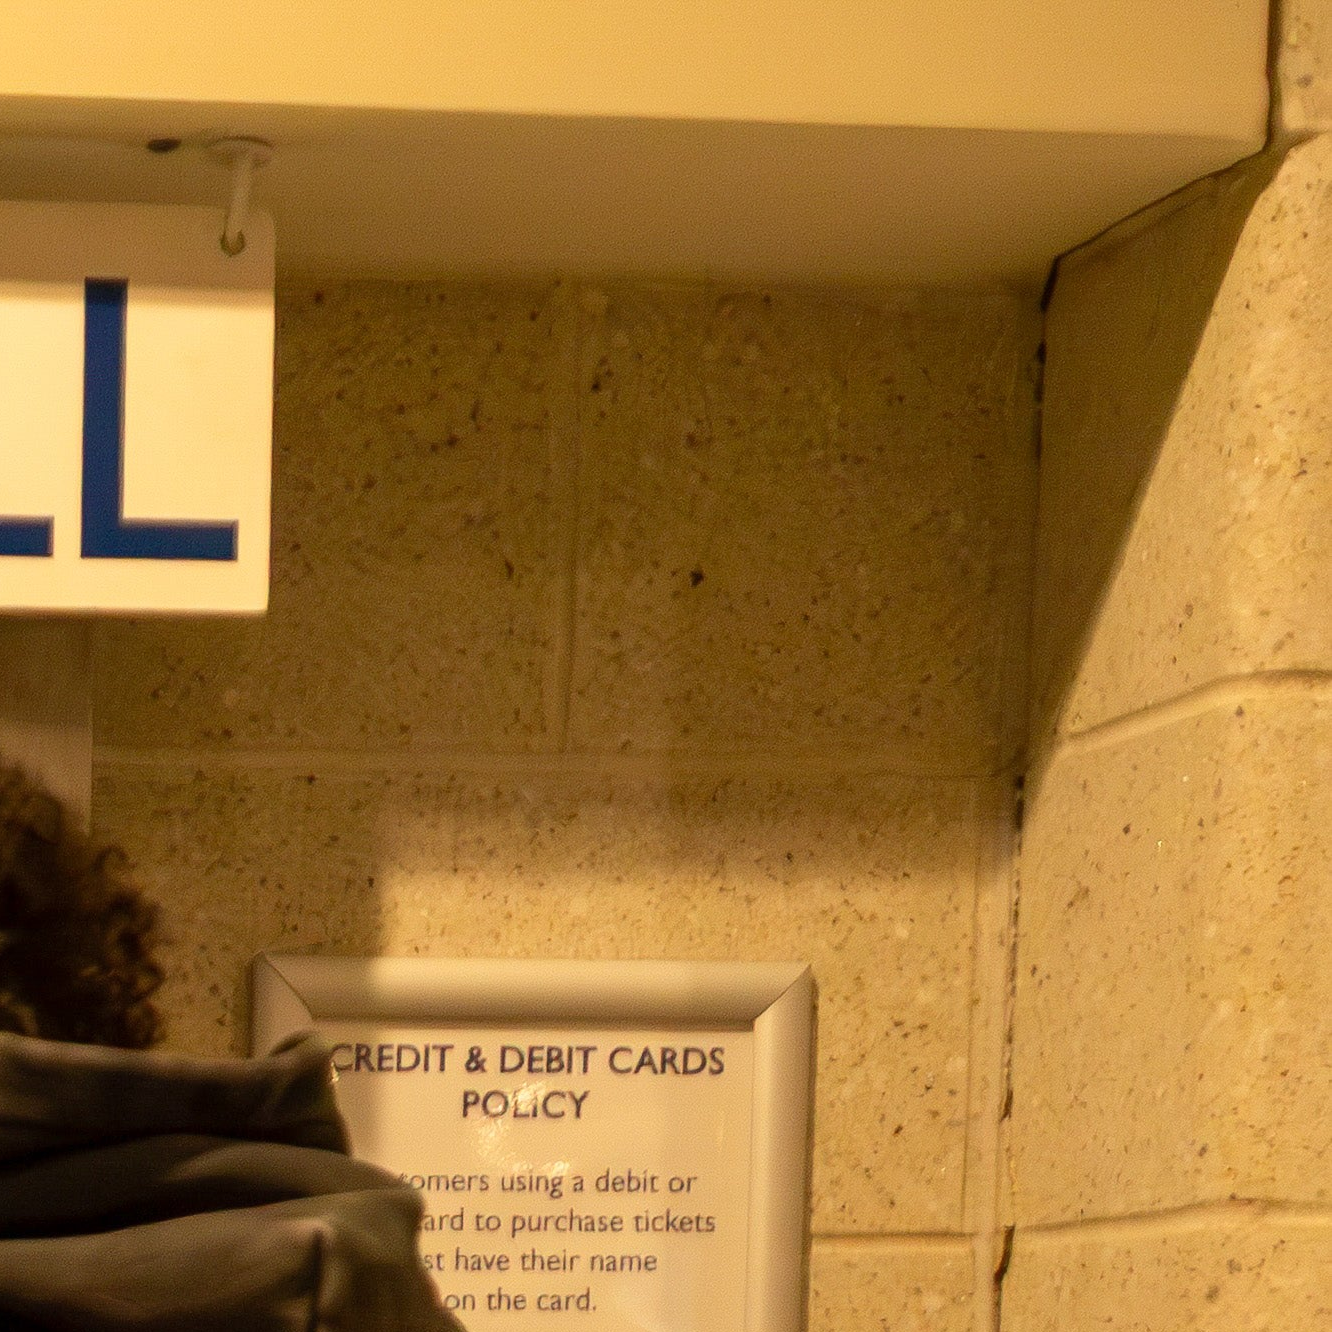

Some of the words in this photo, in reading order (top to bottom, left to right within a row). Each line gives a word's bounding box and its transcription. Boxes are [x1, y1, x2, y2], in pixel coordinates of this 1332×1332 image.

[332, 1043, 455, 1073] CREDIT
[465, 1045, 487, 1074] &
[500, 1045, 597, 1075] DEBIT
[608, 1045, 725, 1076] CARDS
[462, 1089, 591, 1119] POLICY
[400, 1172, 489, 1192] omers
[501, 1171, 564, 1199] using
[571, 1175, 585, 1193] a
[595, 1167, 659, 1193] debit
[668, 1175, 698, 1193] or
[422, 1207, 465, 1232] ard
[475, 1212, 502, 1232] to
[511, 1207, 624, 1239] purchase
[634, 1208, 717, 1233] tickets
[423, 1252, 445, 1272] st
[454, 1246, 510, 1271] have
[520, 1248, 580, 1272] their
[590, 1254, 658, 1272] name
[443, 1293, 476, 1311] on
[487, 1286, 527, 1311] the
[537, 1286, 597, 1312] card.
